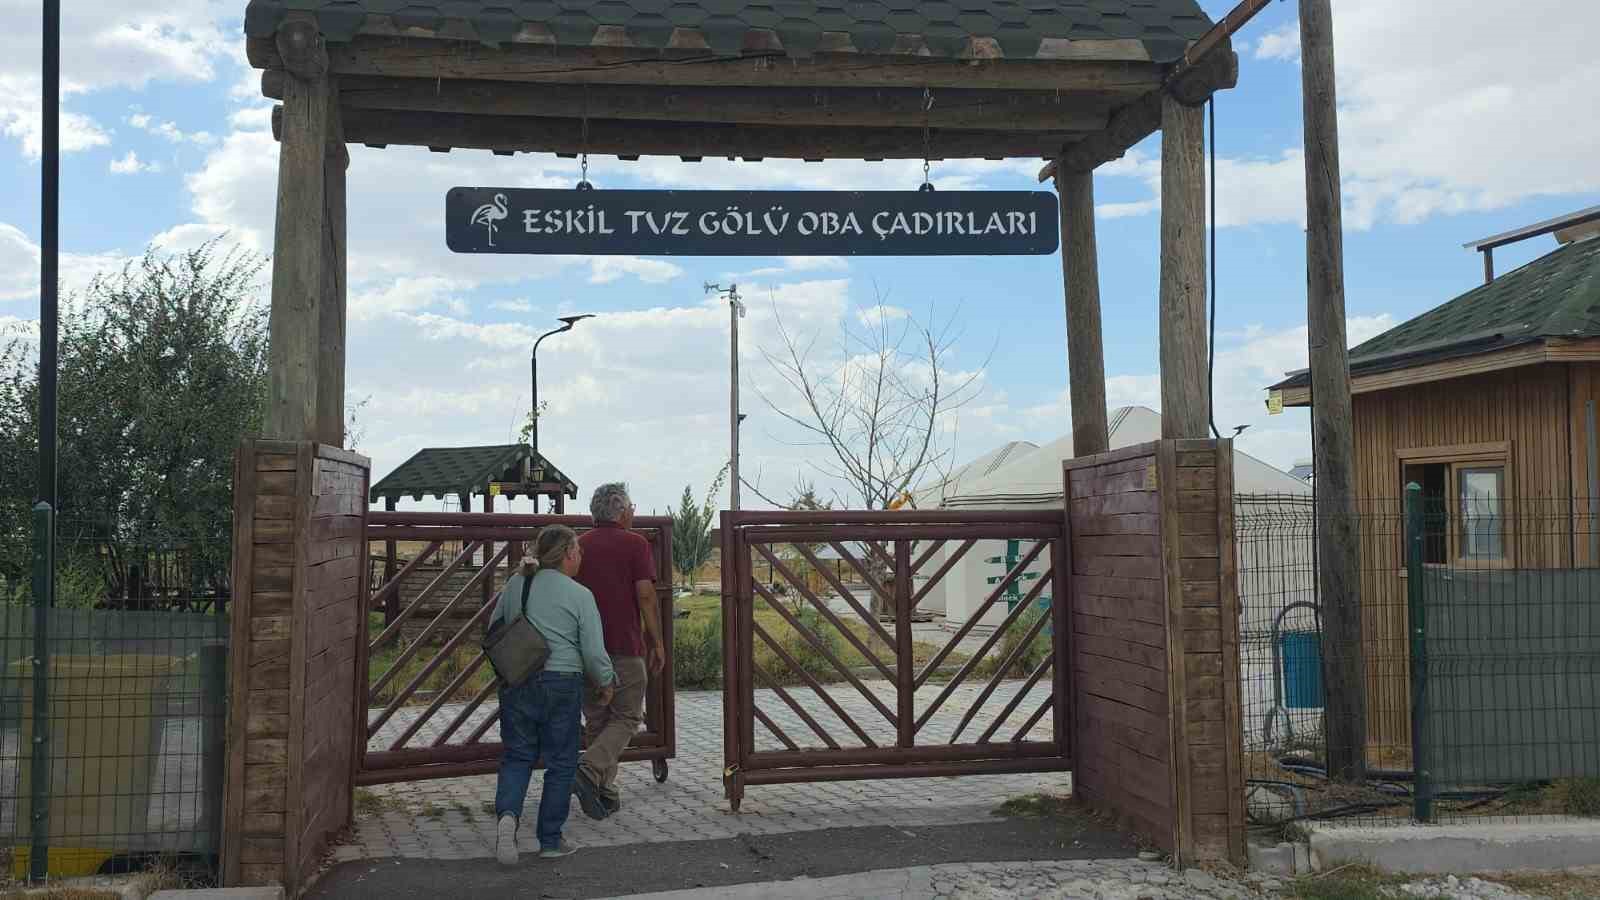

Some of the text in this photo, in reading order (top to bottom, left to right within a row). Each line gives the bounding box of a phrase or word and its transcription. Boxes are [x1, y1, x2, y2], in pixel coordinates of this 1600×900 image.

[522, 204, 615, 234] ESKİL
[698, 206, 790, 236] GÖLÜ
[797, 211, 864, 236] OBA
[871, 211, 1037, 241] ÇADIRLARI
